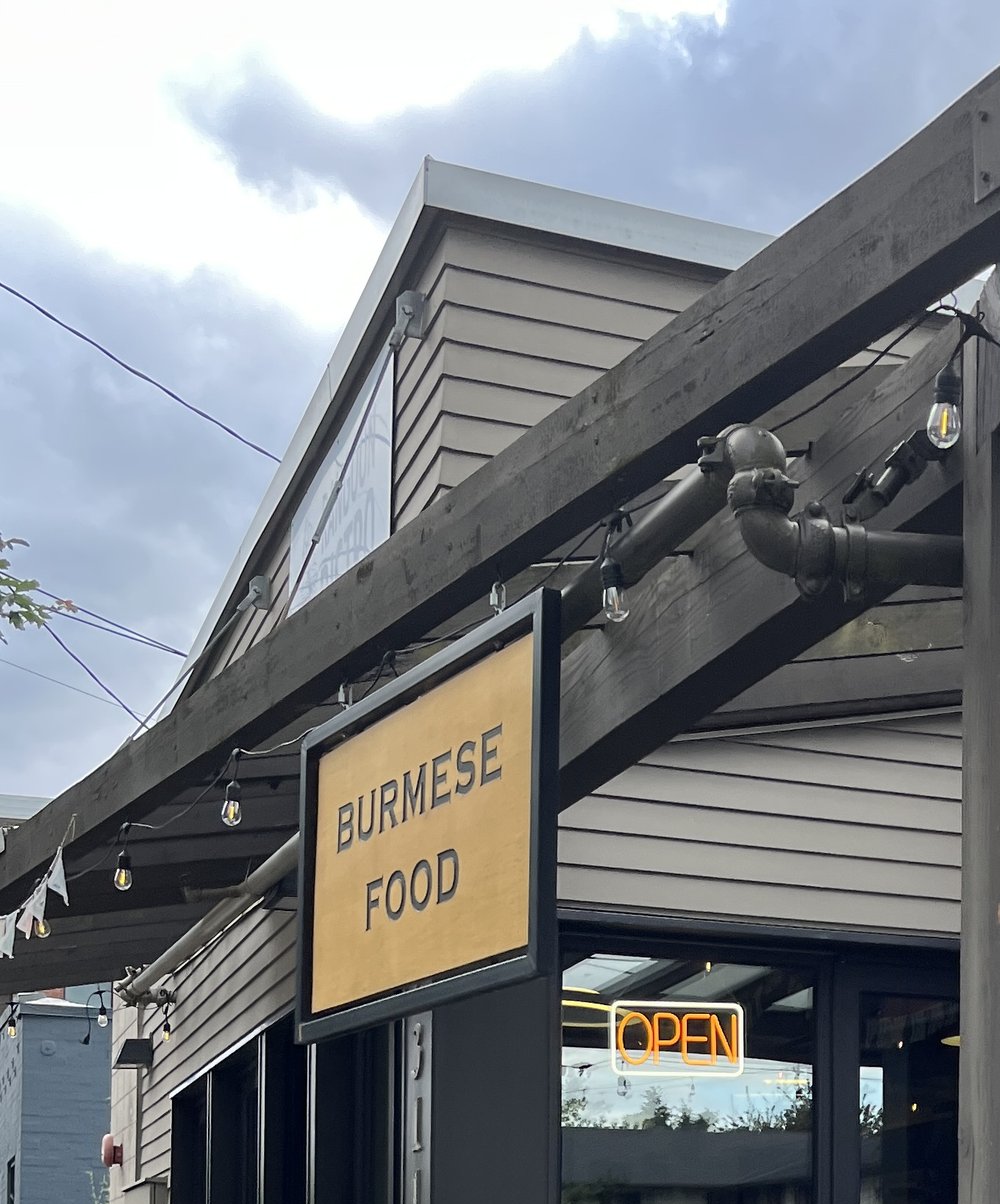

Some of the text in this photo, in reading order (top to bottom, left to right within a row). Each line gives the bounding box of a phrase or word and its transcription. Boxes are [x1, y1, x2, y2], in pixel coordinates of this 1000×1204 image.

[336, 722, 504, 854] BURMESE
[365, 847, 460, 932] FOOD
[617, 1011, 738, 1066] OPEN
